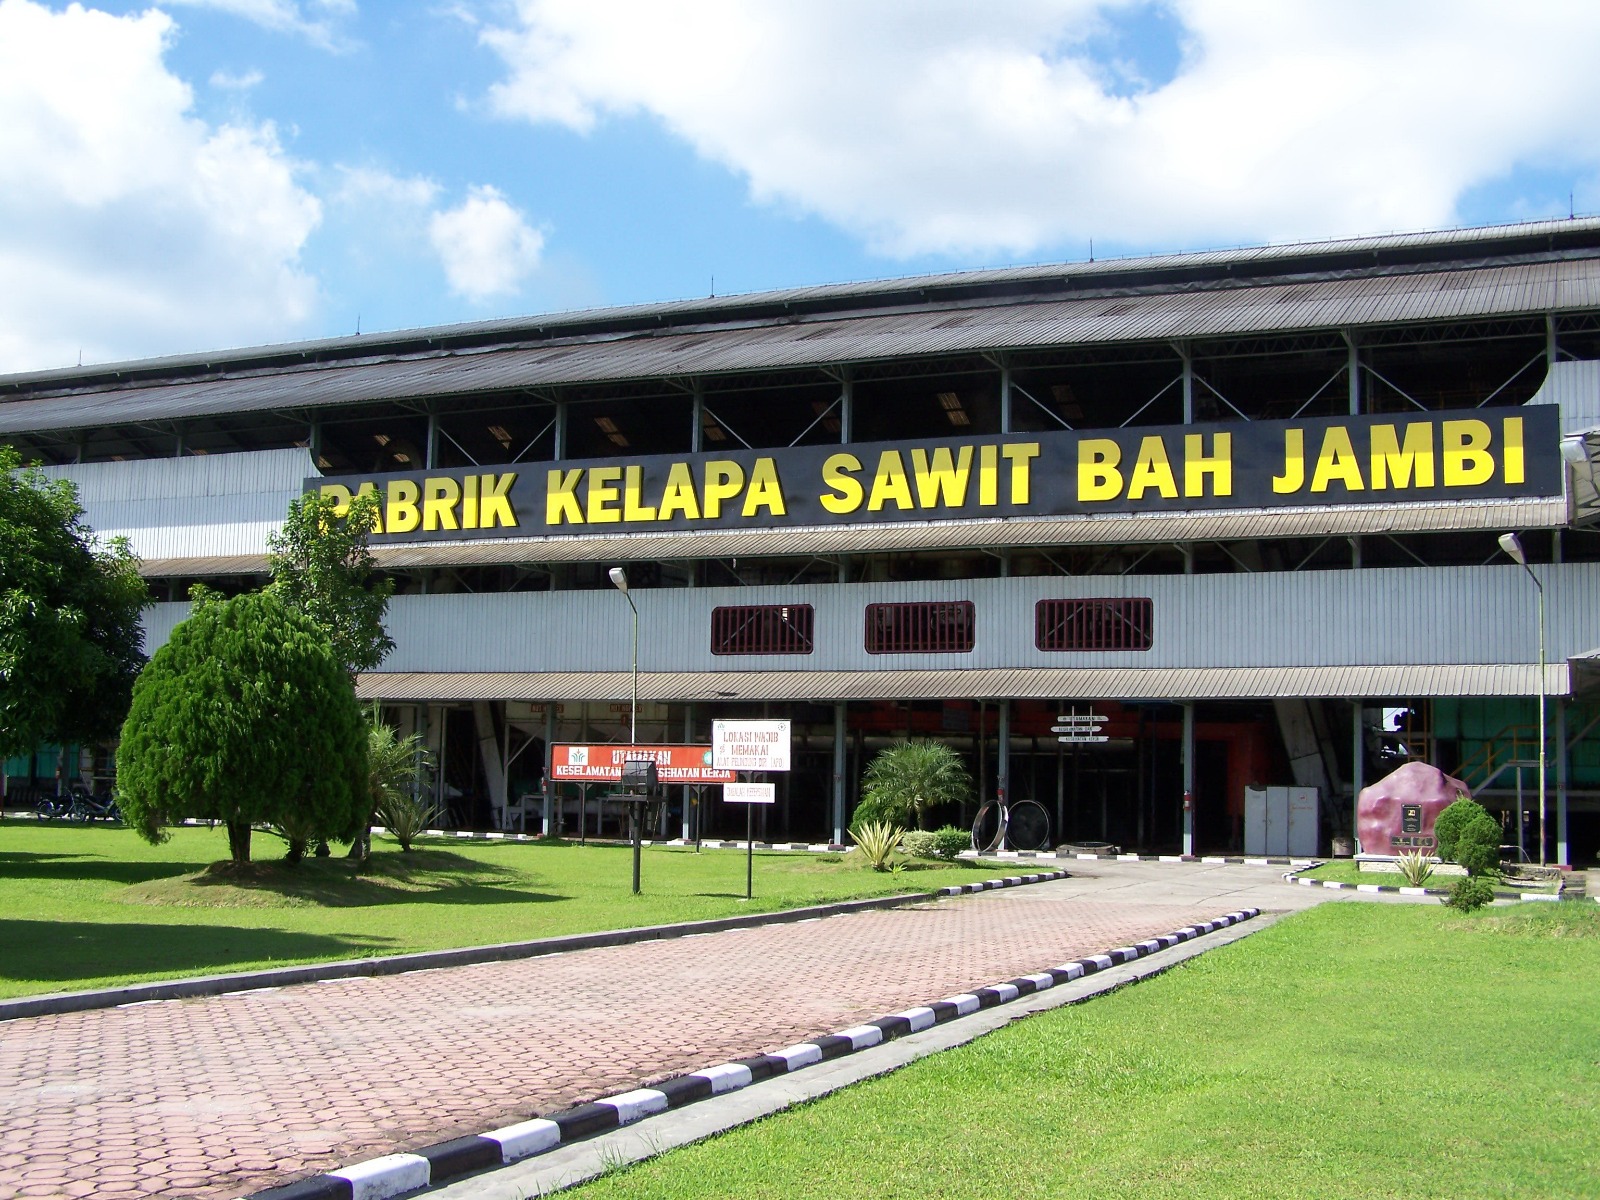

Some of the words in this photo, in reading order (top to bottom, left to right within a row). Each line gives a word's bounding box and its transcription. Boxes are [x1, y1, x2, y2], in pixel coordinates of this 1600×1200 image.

[544, 456, 787, 526] KELAPA
[819, 441, 1040, 515] SAWIT
[1077, 431, 1233, 503] BAH
[1271, 416, 1526, 496] JAMBI
[723, 731, 752, 742] LOKASI
[754, 731, 779, 742] WAJIB
[731, 744, 768, 755] MEMAKAI
[612, 750, 671, 765] UTAMAKAN
[556, 765, 621, 777] KESELAMATAN
[701, 768, 731, 778] KERJA
